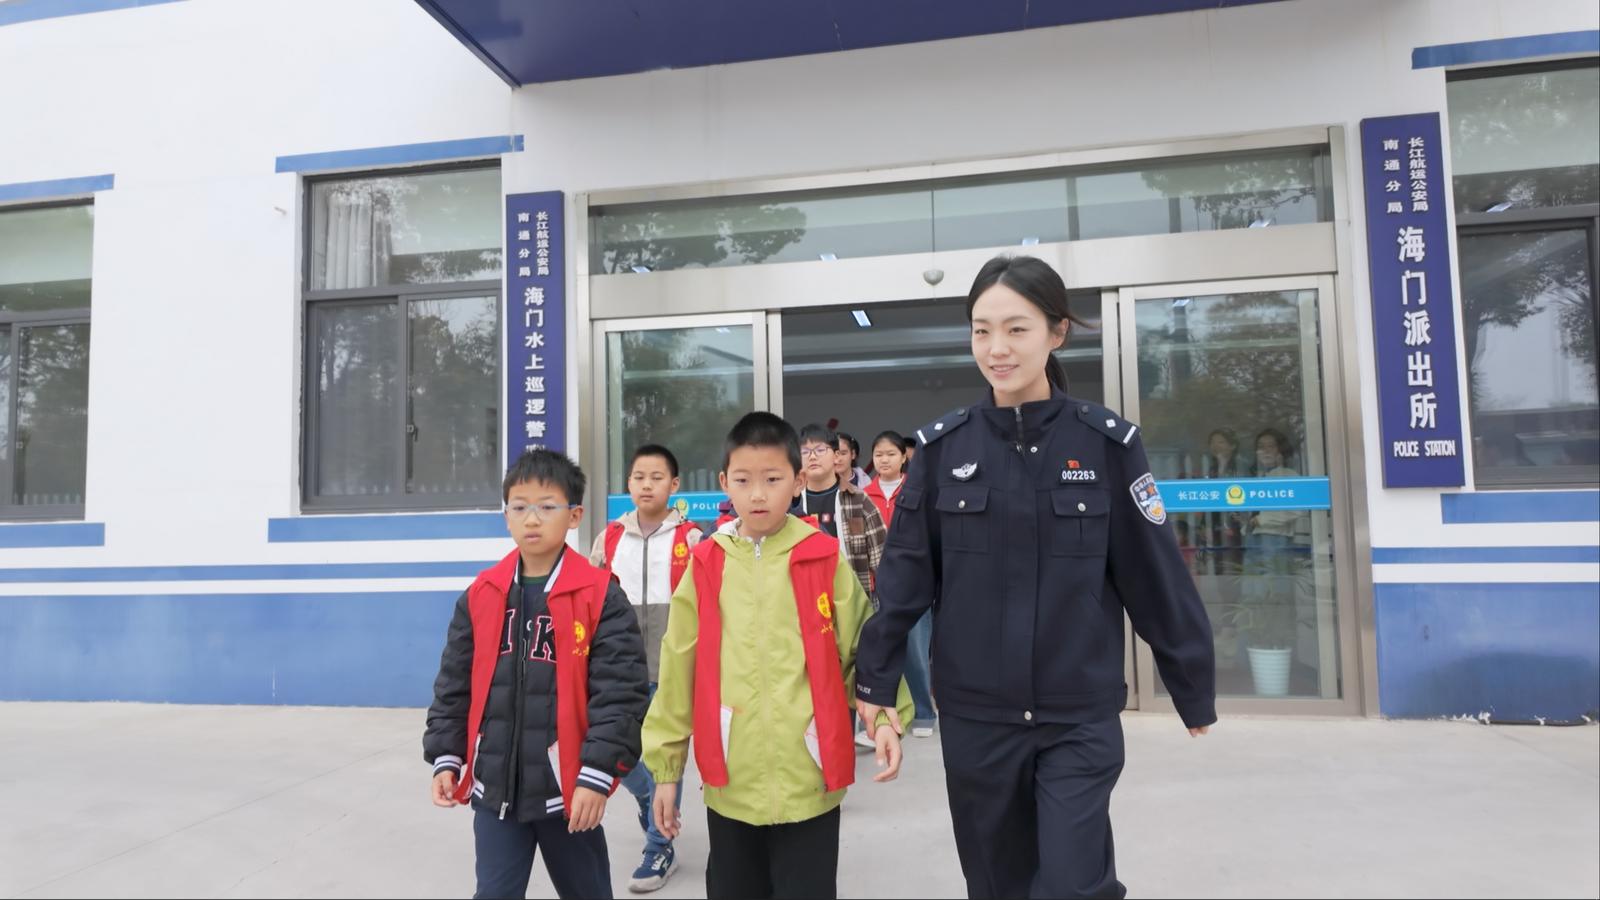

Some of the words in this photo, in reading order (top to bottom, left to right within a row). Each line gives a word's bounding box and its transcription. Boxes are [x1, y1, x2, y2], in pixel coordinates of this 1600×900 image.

[1383, 139, 1403, 214] 南通分局
[1407, 136, 1429, 212] 长江航运公安局
[517, 212, 531, 277] 南通分局
[536, 210, 550, 276] 长江航运公安局
[1397, 226, 1437, 429] 海门派出所
[1061, 470, 1096, 480] 002263
[1393, 440, 1420, 457] POLICE
[1424, 439, 1456, 457] STATION
[1177, 489, 1220, 501] 长江公安
[1250, 489, 1294, 498] POLICE
